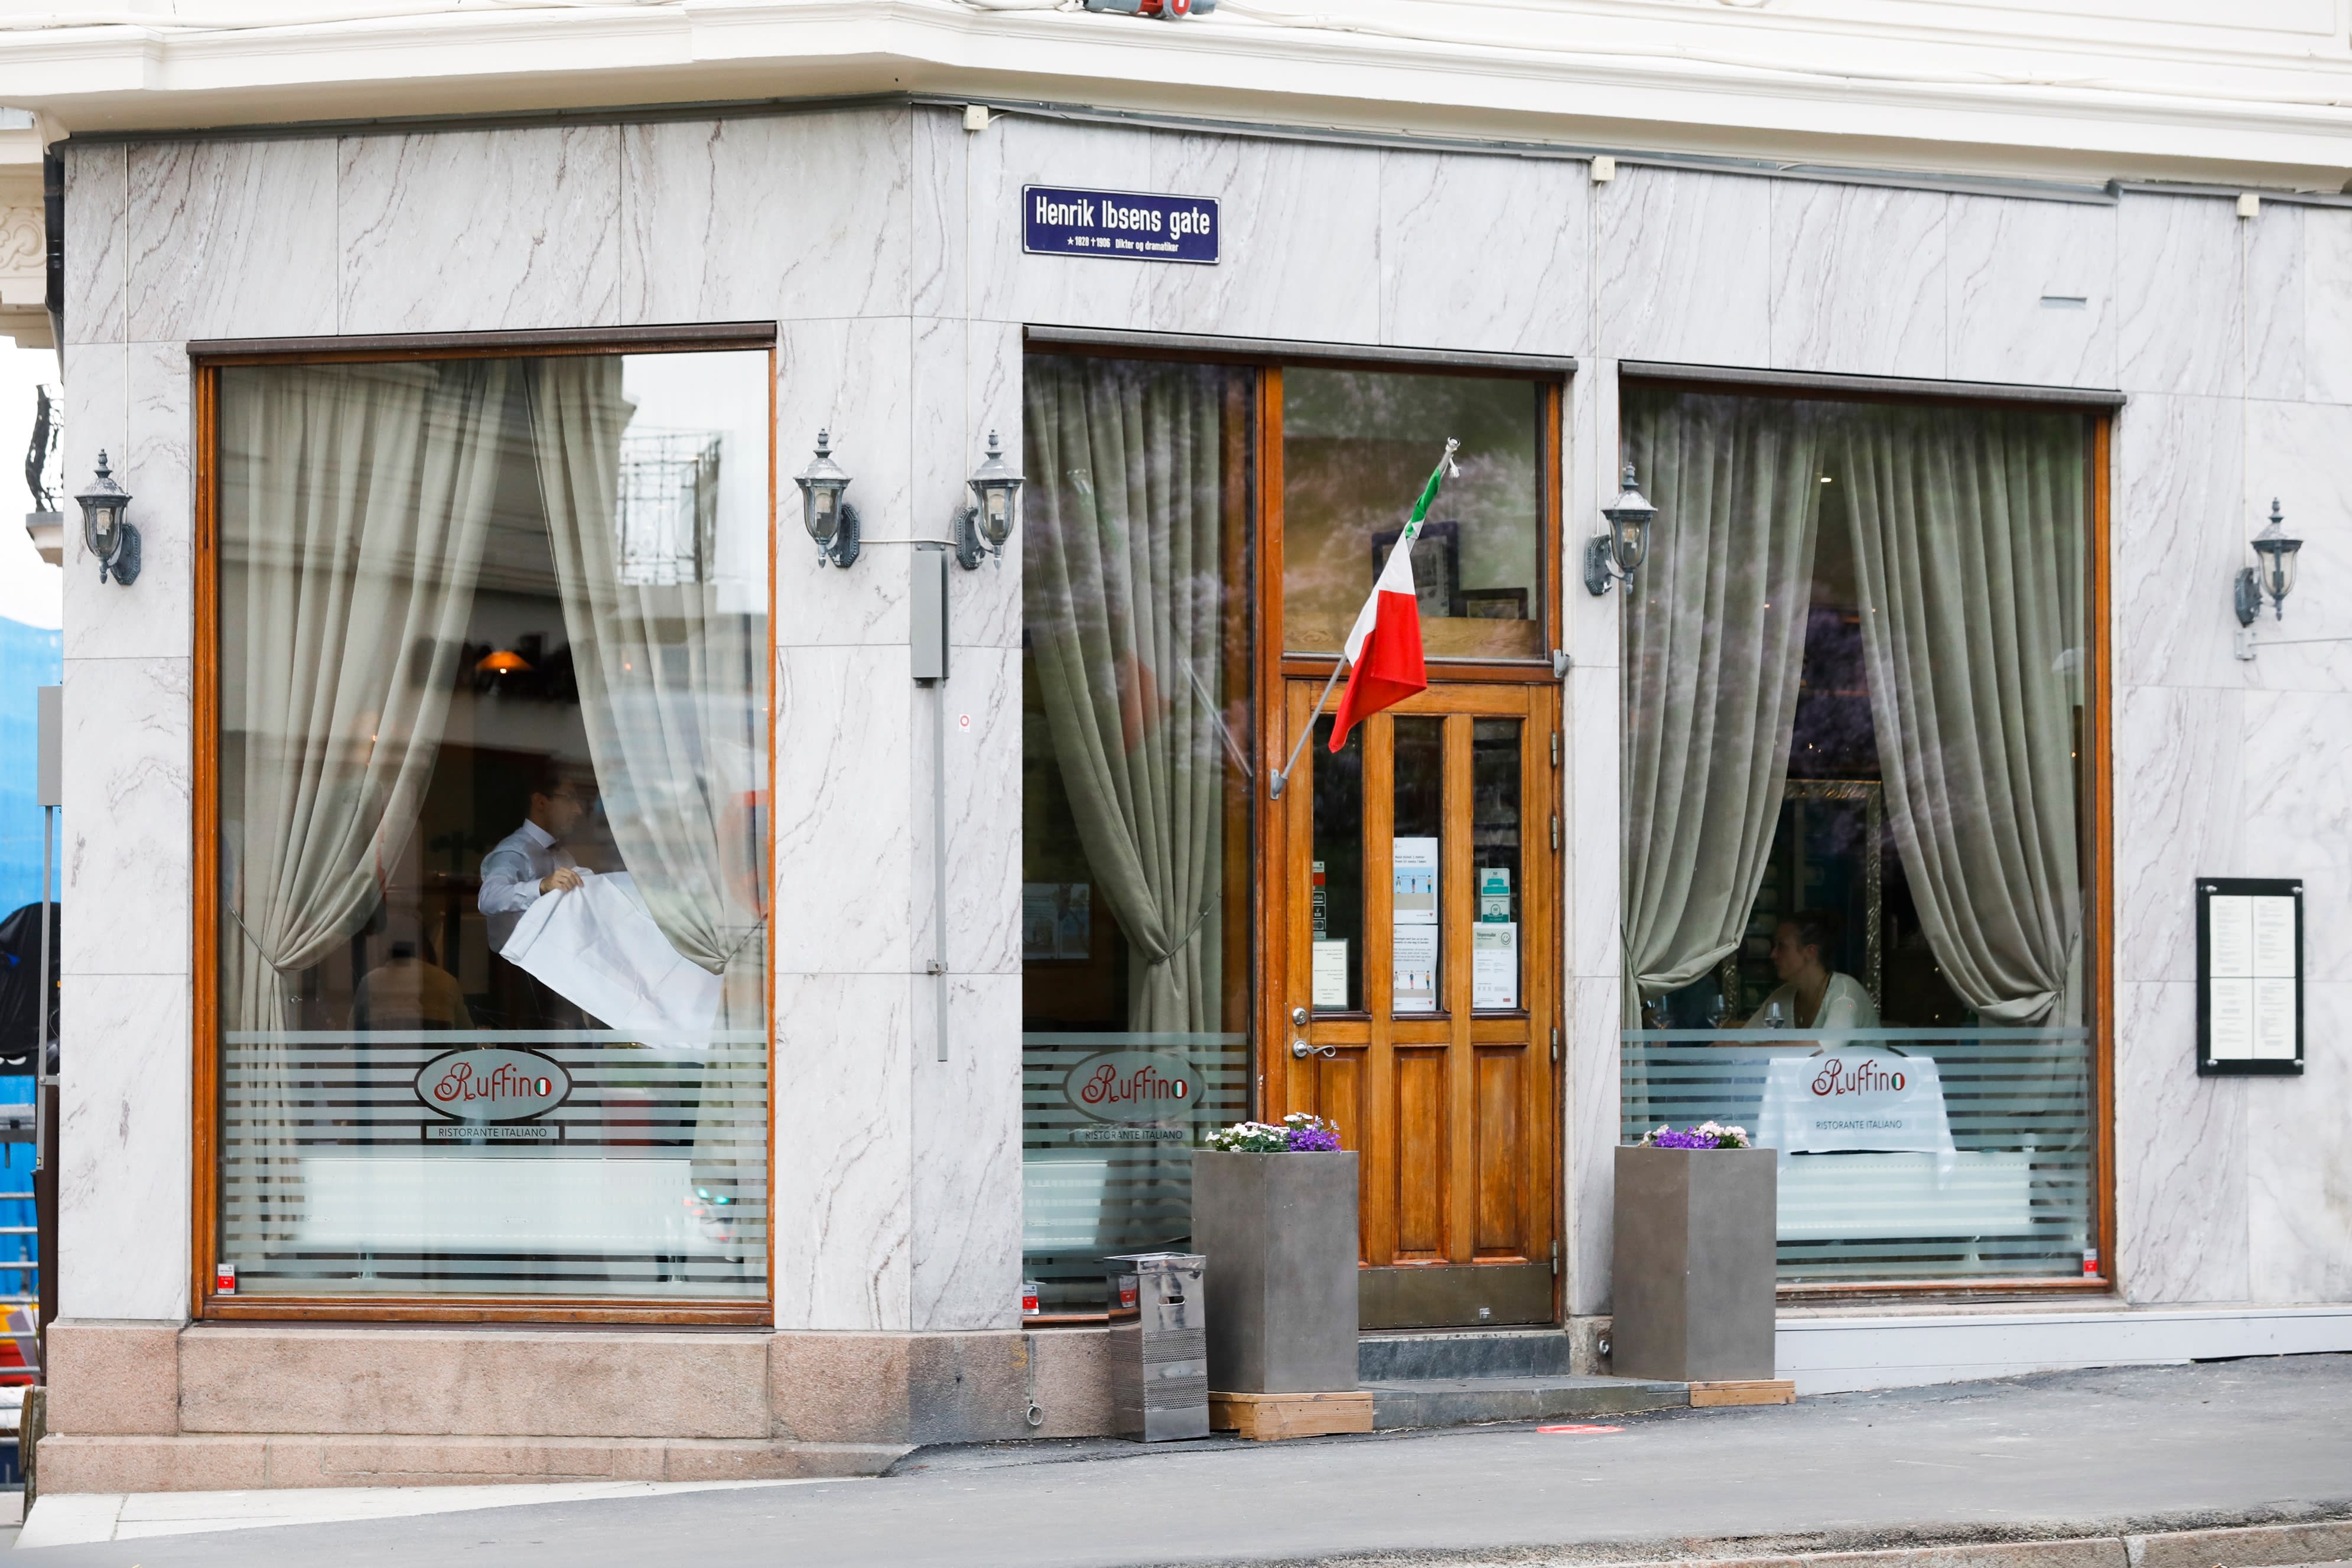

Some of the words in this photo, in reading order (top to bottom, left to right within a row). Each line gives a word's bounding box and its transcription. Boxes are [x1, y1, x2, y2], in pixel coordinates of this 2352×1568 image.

[1036, 196, 1095, 227] Henrik
[1102, 200, 1162, 232] Ibsens
[1169, 206, 1211, 240] gate
[1115, 238, 1134, 249] Dikter
[1136, 241, 1144, 252] og
[1145, 240, 1179, 252] dramatiker
[434, 1062, 552, 1102] Ruffino
[1081, 1063, 1188, 1104] Ruffino
[1811, 1058, 1905, 1096] Ruffino
[438, 1128, 499, 1137] RISTORANTE
[502, 1128, 547, 1137] ITALIANO
[1085, 1130, 1140, 1140] RISTORANTE
[1142, 1130, 1183, 1140] ITALIANO
[1816, 1120, 1864, 1130] RISTORANTE
[1866, 1120, 1902, 1129] ITALIANO
